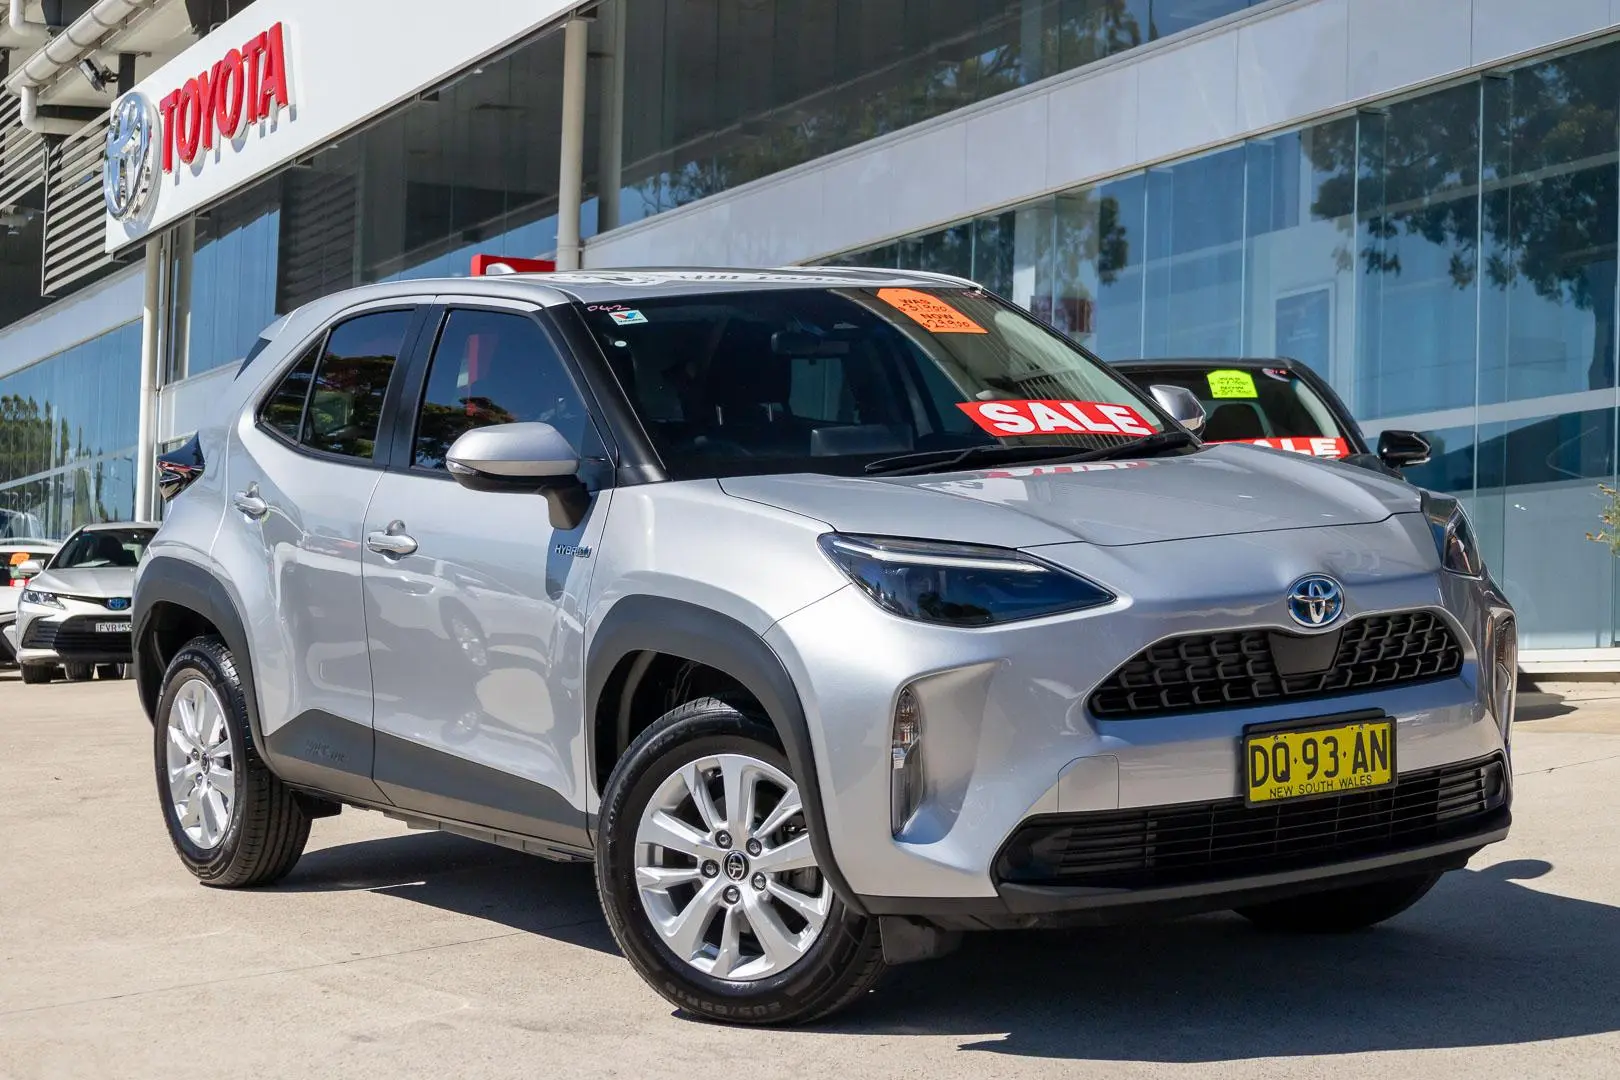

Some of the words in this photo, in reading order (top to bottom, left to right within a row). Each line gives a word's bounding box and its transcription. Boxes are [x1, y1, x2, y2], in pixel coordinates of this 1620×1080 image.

[160, 22, 288, 174] TOYOTA
[978, 402, 1153, 436] SALE
[1253, 438, 1341, 457] LE
[1250, 741, 1291, 788] DQ
[1302, 735, 1340, 780] 93
[1352, 729, 1388, 775] AN
[1269, 785, 1294, 798] NEW
[1298, 780, 1334, 795] SOUTH
[1339, 775, 1373, 789] WALES
